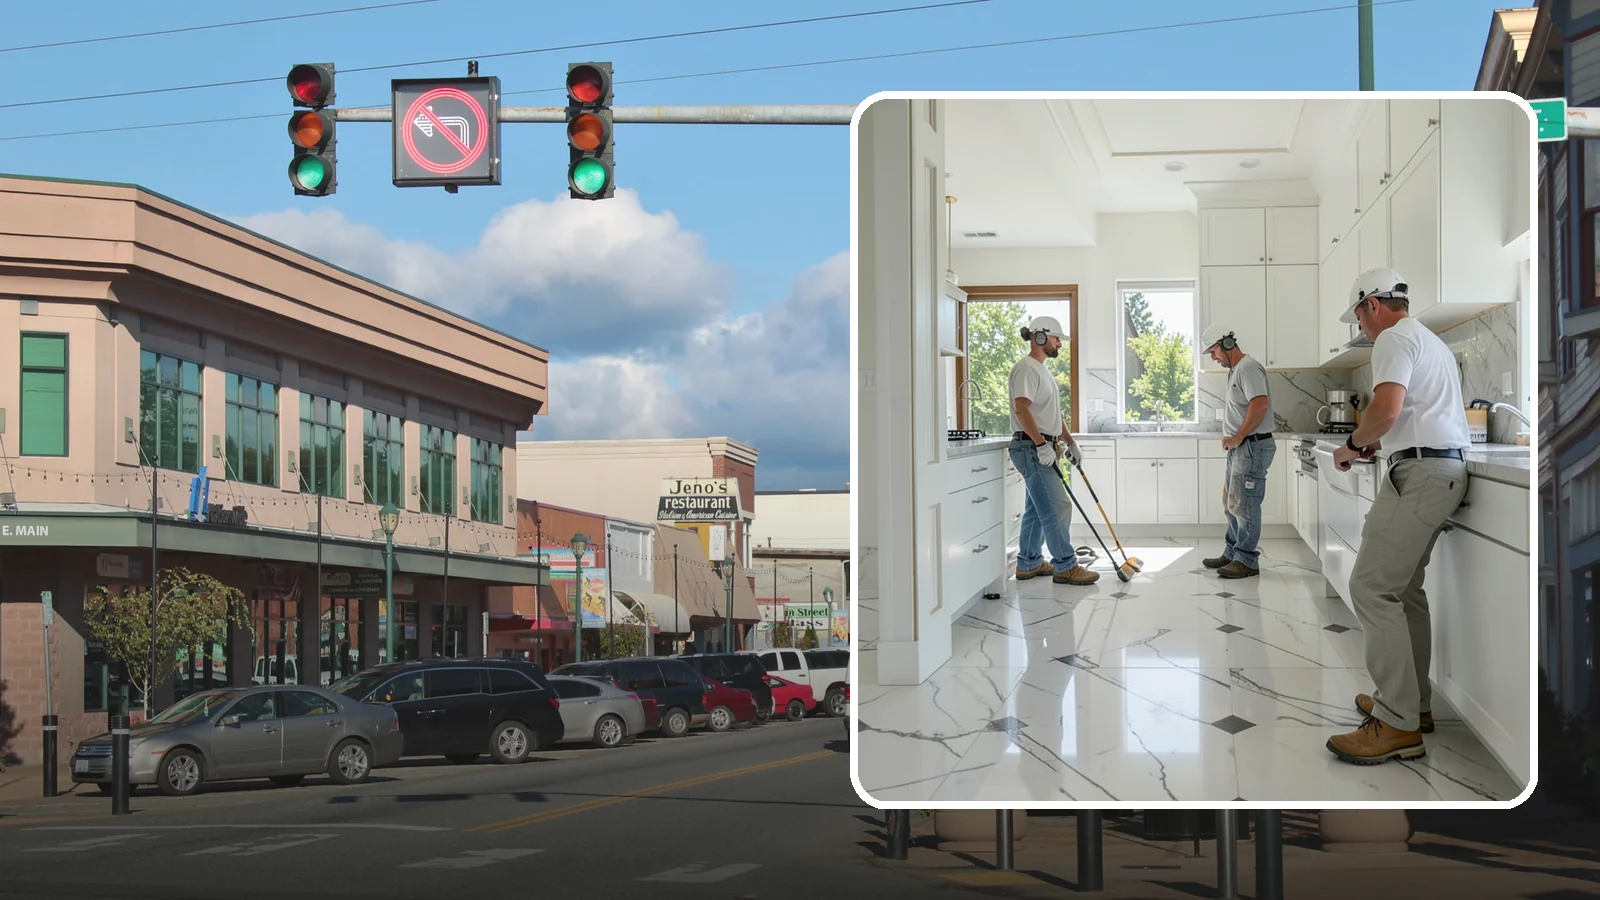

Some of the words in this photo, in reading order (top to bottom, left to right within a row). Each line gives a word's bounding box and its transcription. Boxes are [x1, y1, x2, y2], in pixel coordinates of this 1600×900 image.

[669, 480, 728, 494] Jeno's
[665, 496, 731, 509] restaurant
[659, 510, 681, 519] Italian
[686, 510, 714, 519] American
[715, 509, 737, 519] Cuisine
[2, 525, 13, 536] E.
[15, 525, 49, 536] MAIN
[797, 607, 828, 617] Street
